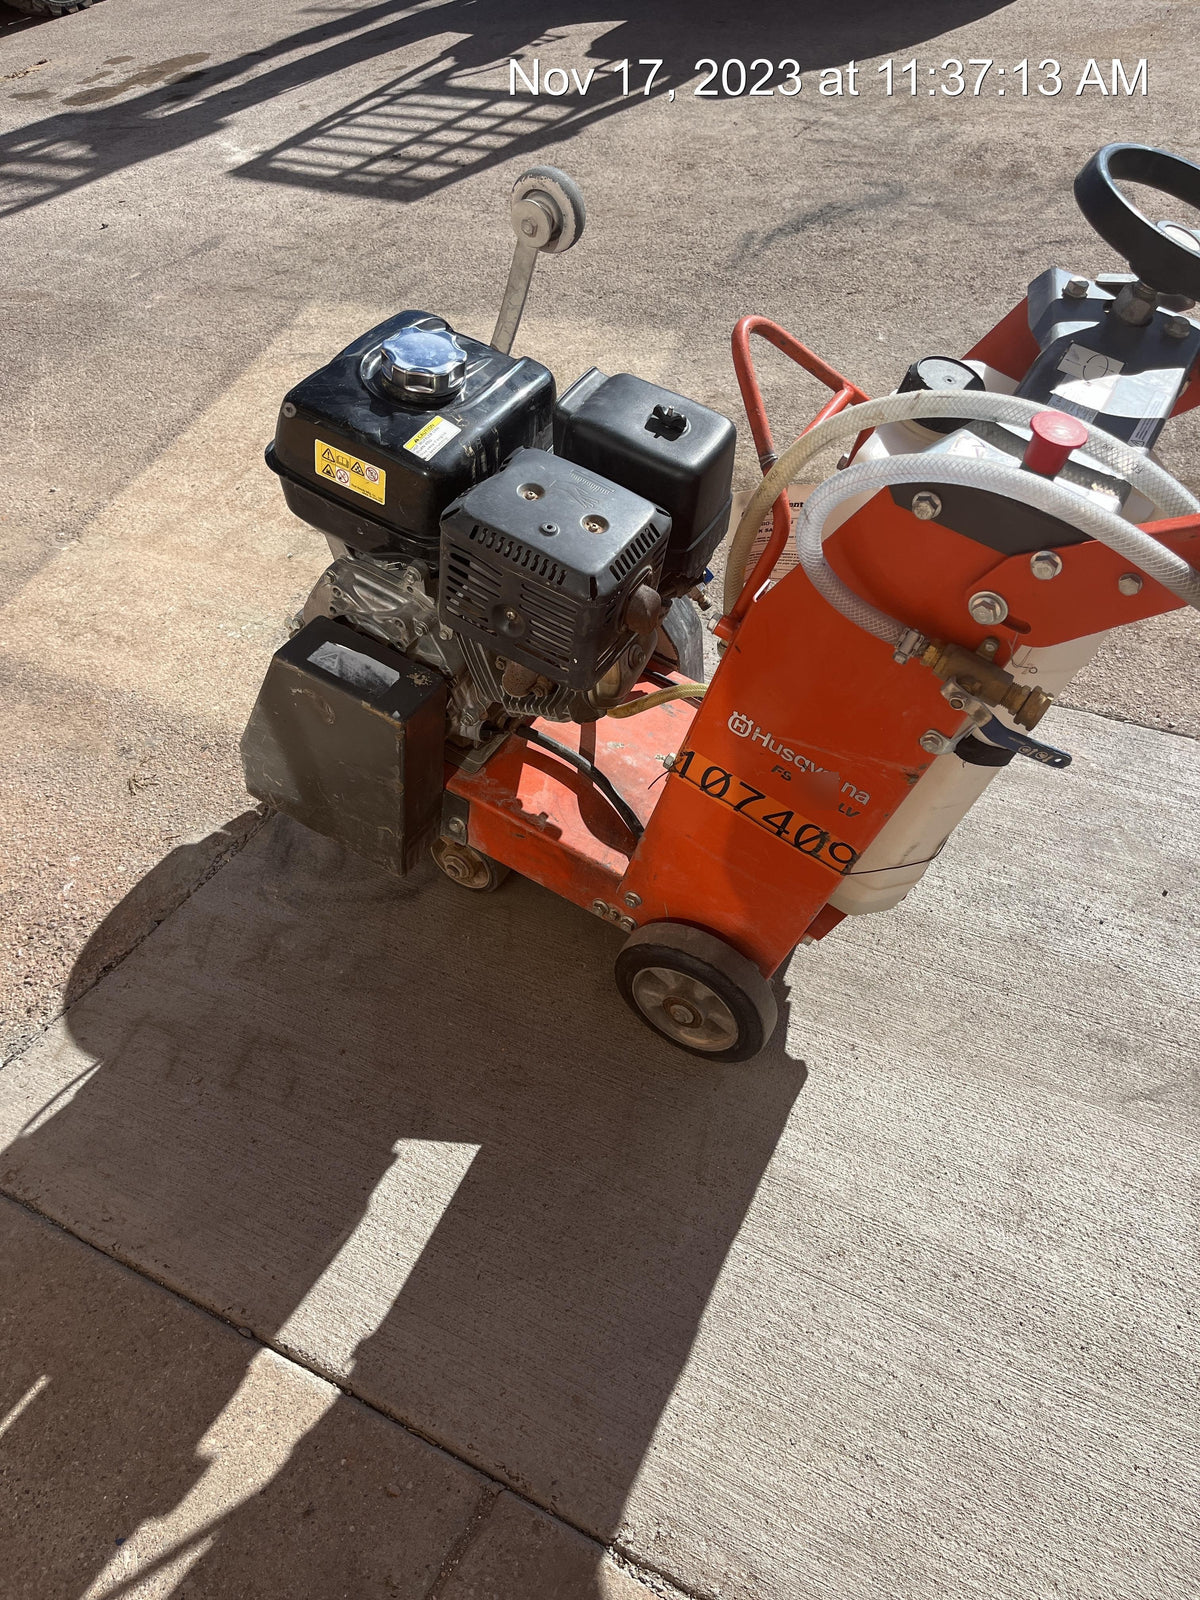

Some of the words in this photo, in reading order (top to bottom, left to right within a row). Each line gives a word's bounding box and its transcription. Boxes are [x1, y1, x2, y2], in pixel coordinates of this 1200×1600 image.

[751, 726, 870, 806] Husqvna
[771, 764, 792, 782] FS
[838, 803, 861, 818] LV
